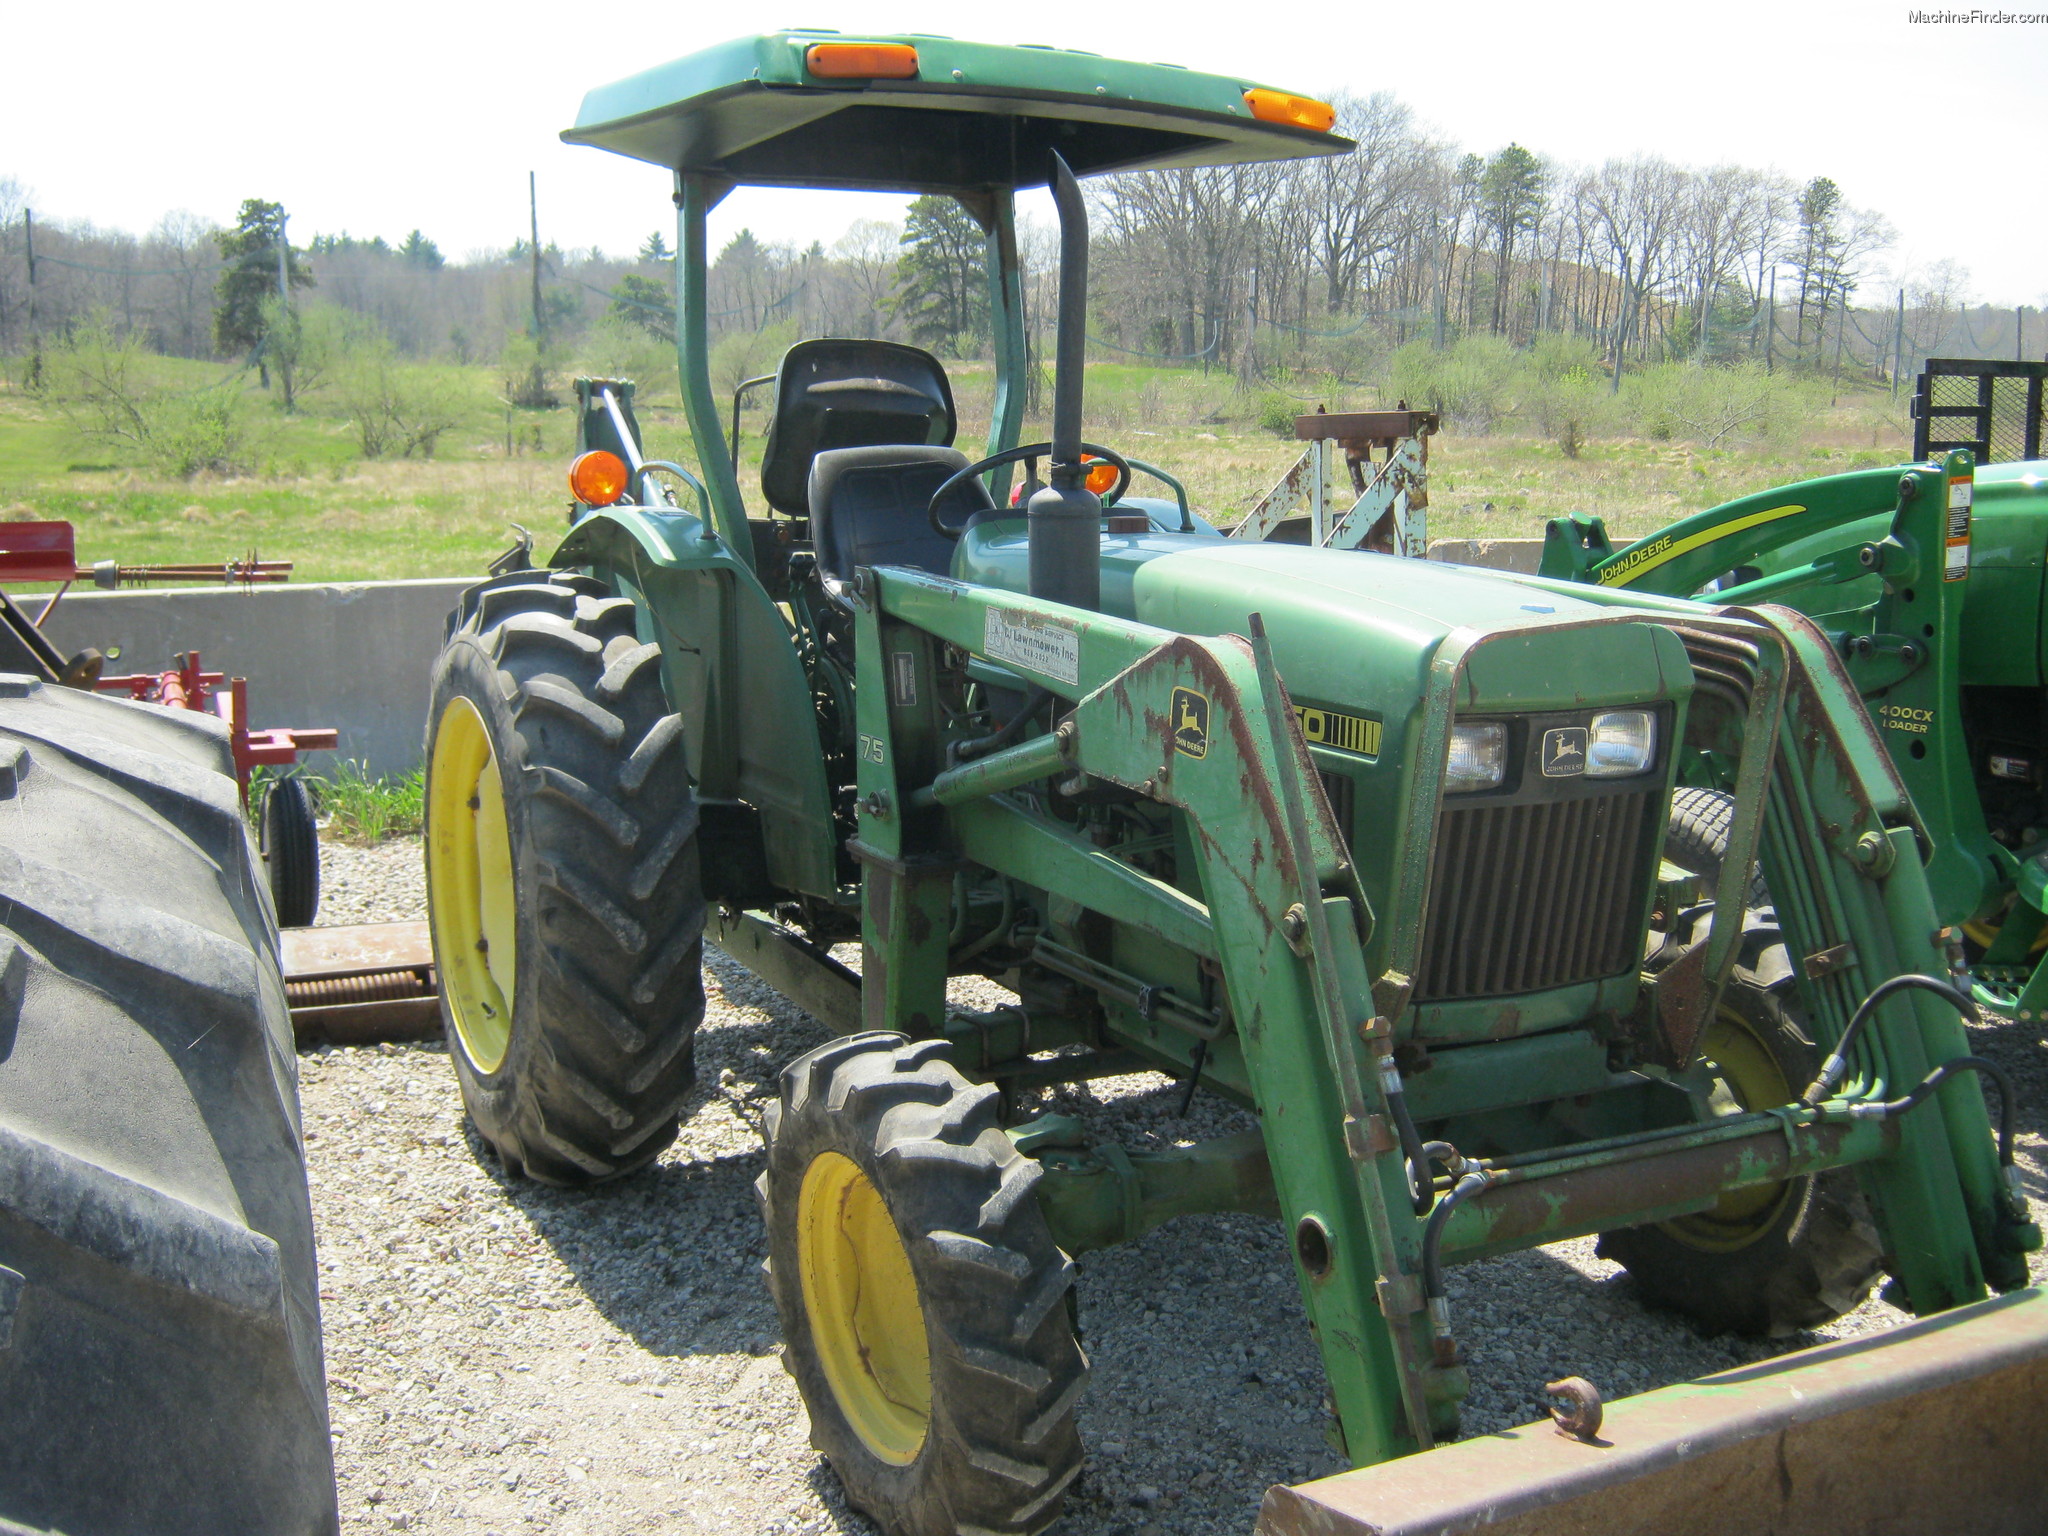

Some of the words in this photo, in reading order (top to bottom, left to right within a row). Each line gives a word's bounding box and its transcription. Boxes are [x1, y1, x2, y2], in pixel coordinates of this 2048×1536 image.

[1596, 558, 1630, 586] JOHN
[1629, 535, 1674, 567] DEERE
[1013, 630, 1061, 658] Lawnmower,
[1061, 645, 1077, 663] Inc.
[1879, 705, 1935, 723] 400CX
[1882, 719, 1928, 734] LOADER
[859, 733, 884, 764] 75
[1175, 735, 1187, 748] OHN
[1187, 741, 1205, 755] DEERE
[1546, 764, 1564, 773] JOHN
[1564, 763, 1584, 771] DEERE
